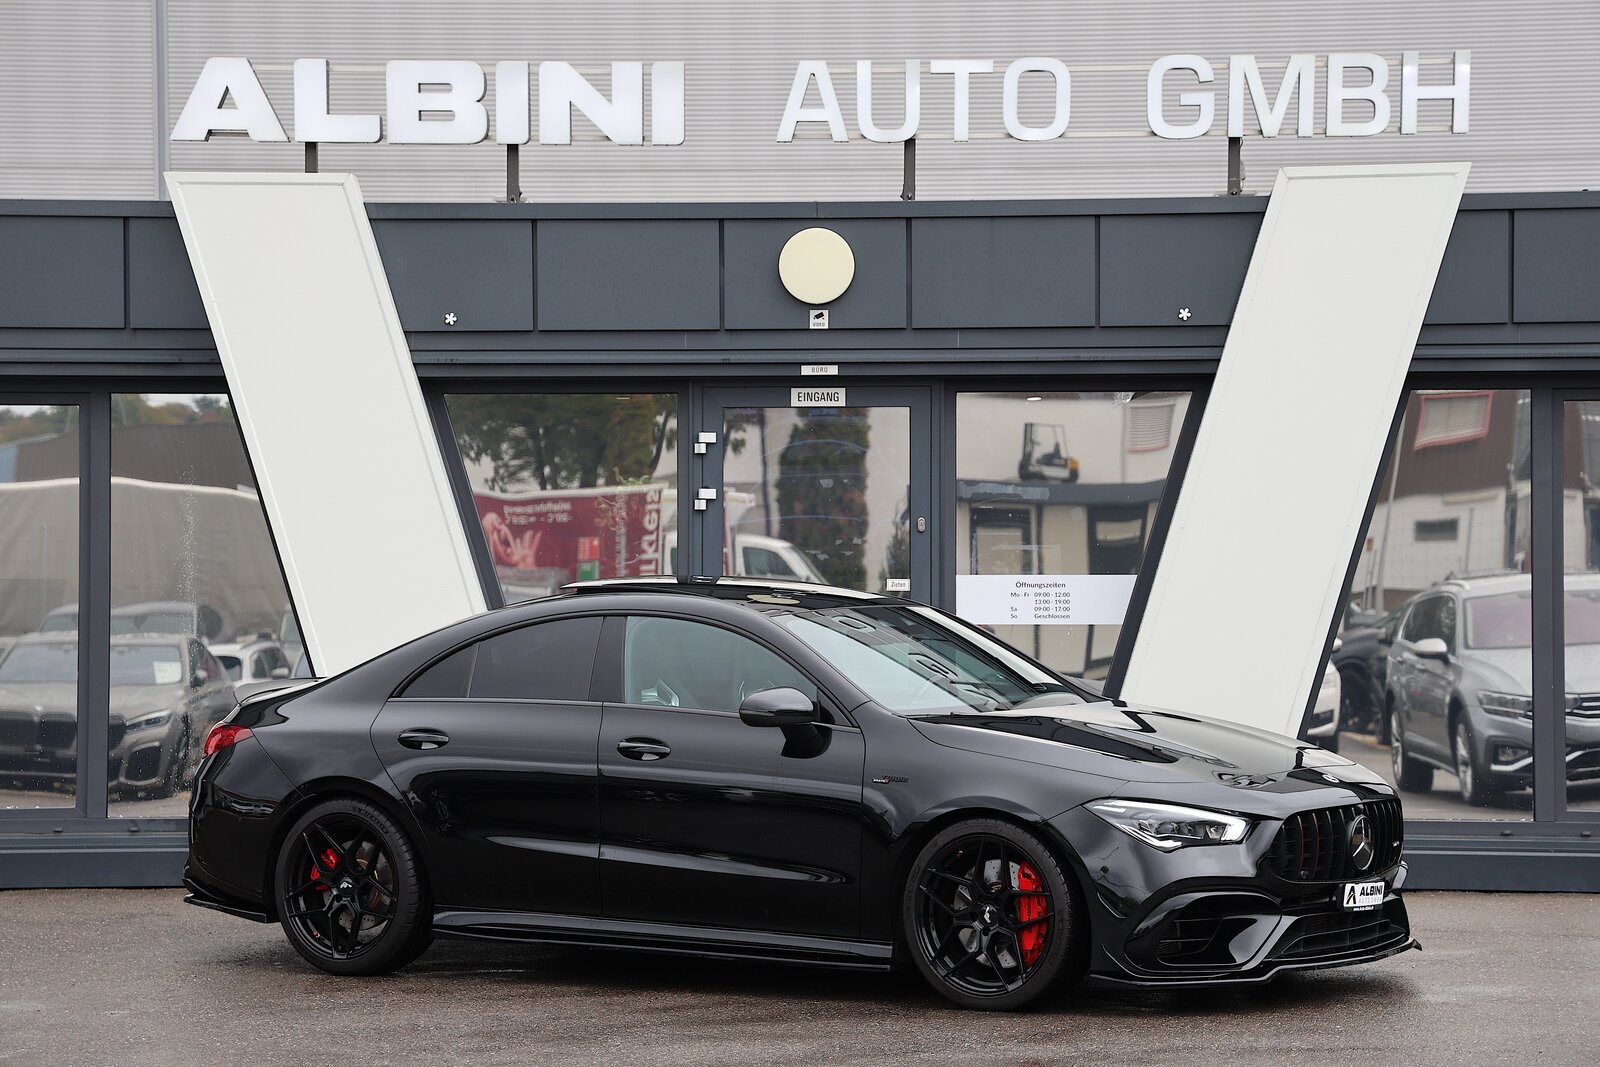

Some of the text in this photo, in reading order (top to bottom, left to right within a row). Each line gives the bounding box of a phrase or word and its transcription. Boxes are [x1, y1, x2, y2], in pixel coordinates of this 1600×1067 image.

[170, 49, 1472, 146] ALBINI AUTO GMBH
[797, 391, 840, 402] EINGANG
[1015, 581, 1066, 589] Öffnungszeiten
[1360, 885, 1383, 896] ALBINI
